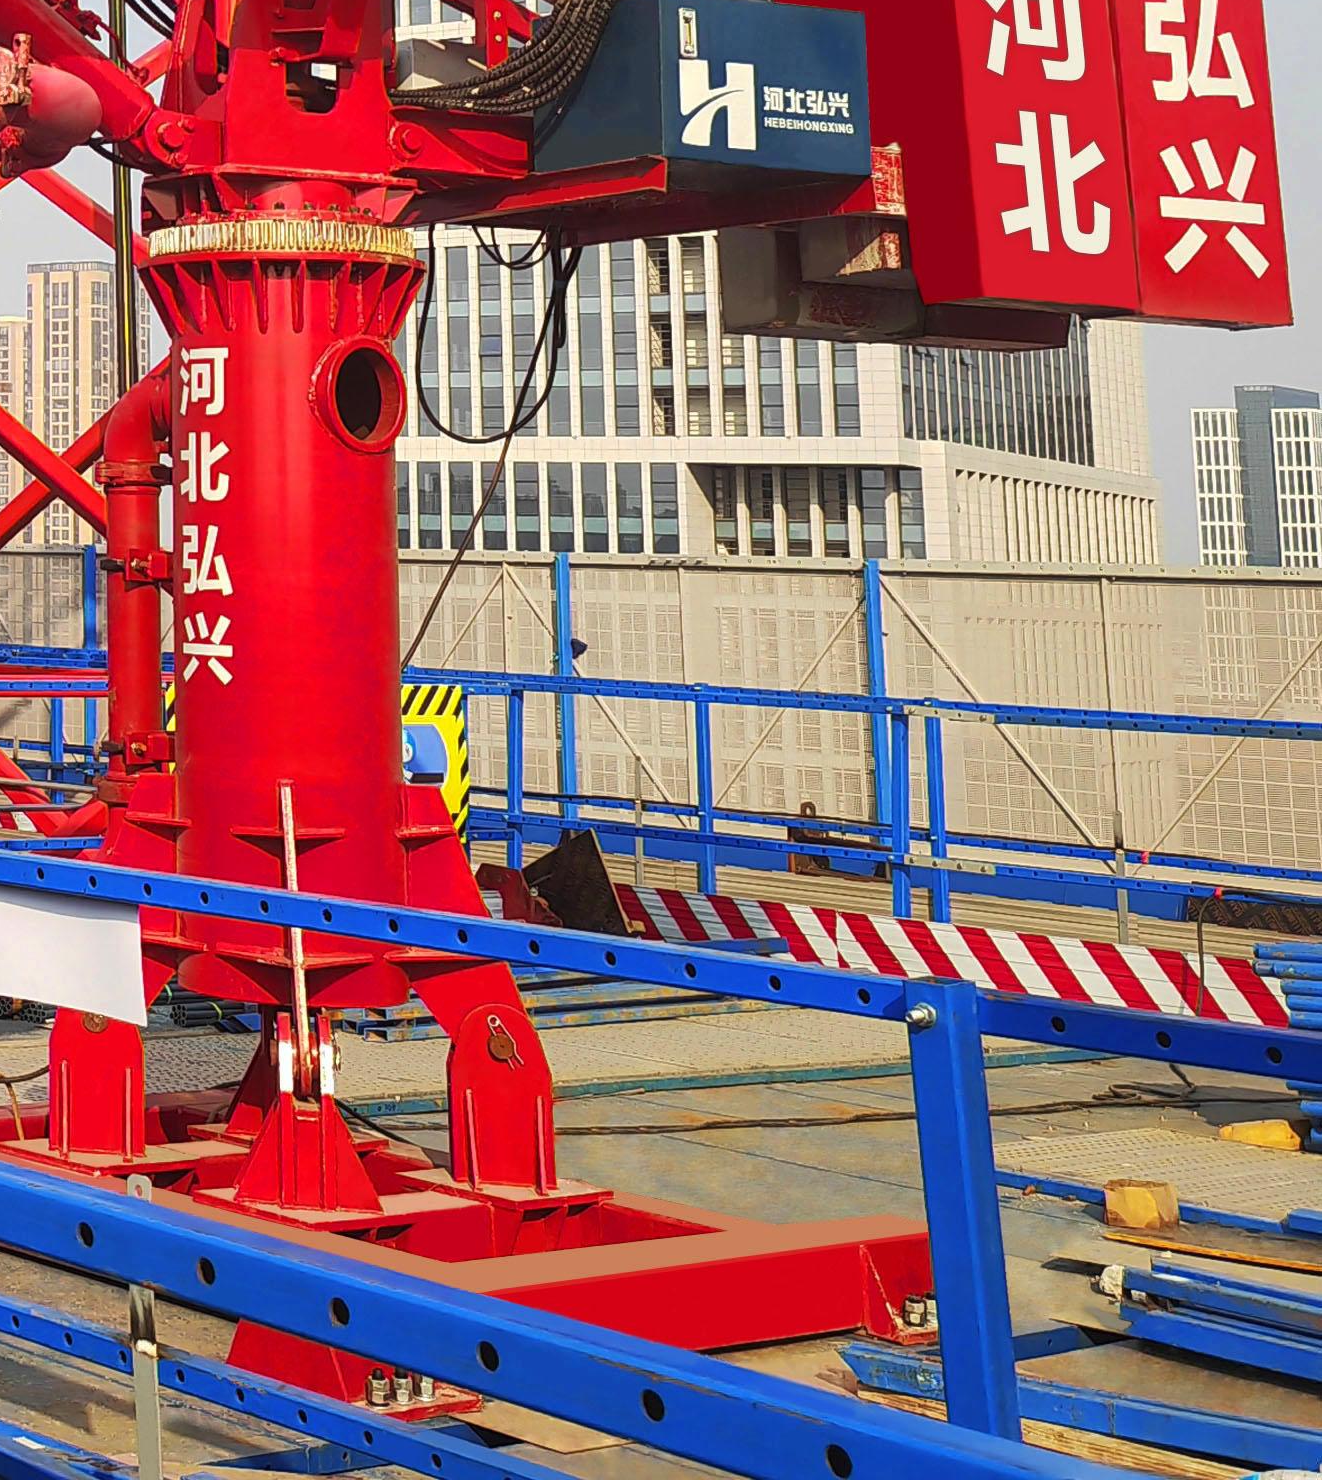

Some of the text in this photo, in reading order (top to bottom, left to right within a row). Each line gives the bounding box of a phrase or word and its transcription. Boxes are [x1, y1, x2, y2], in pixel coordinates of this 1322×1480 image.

[763, 85, 851, 118] 河北弘兴
[764, 117, 854, 135] HEBEIHONGXING
[179, 346, 235, 686] 河北弘兴
